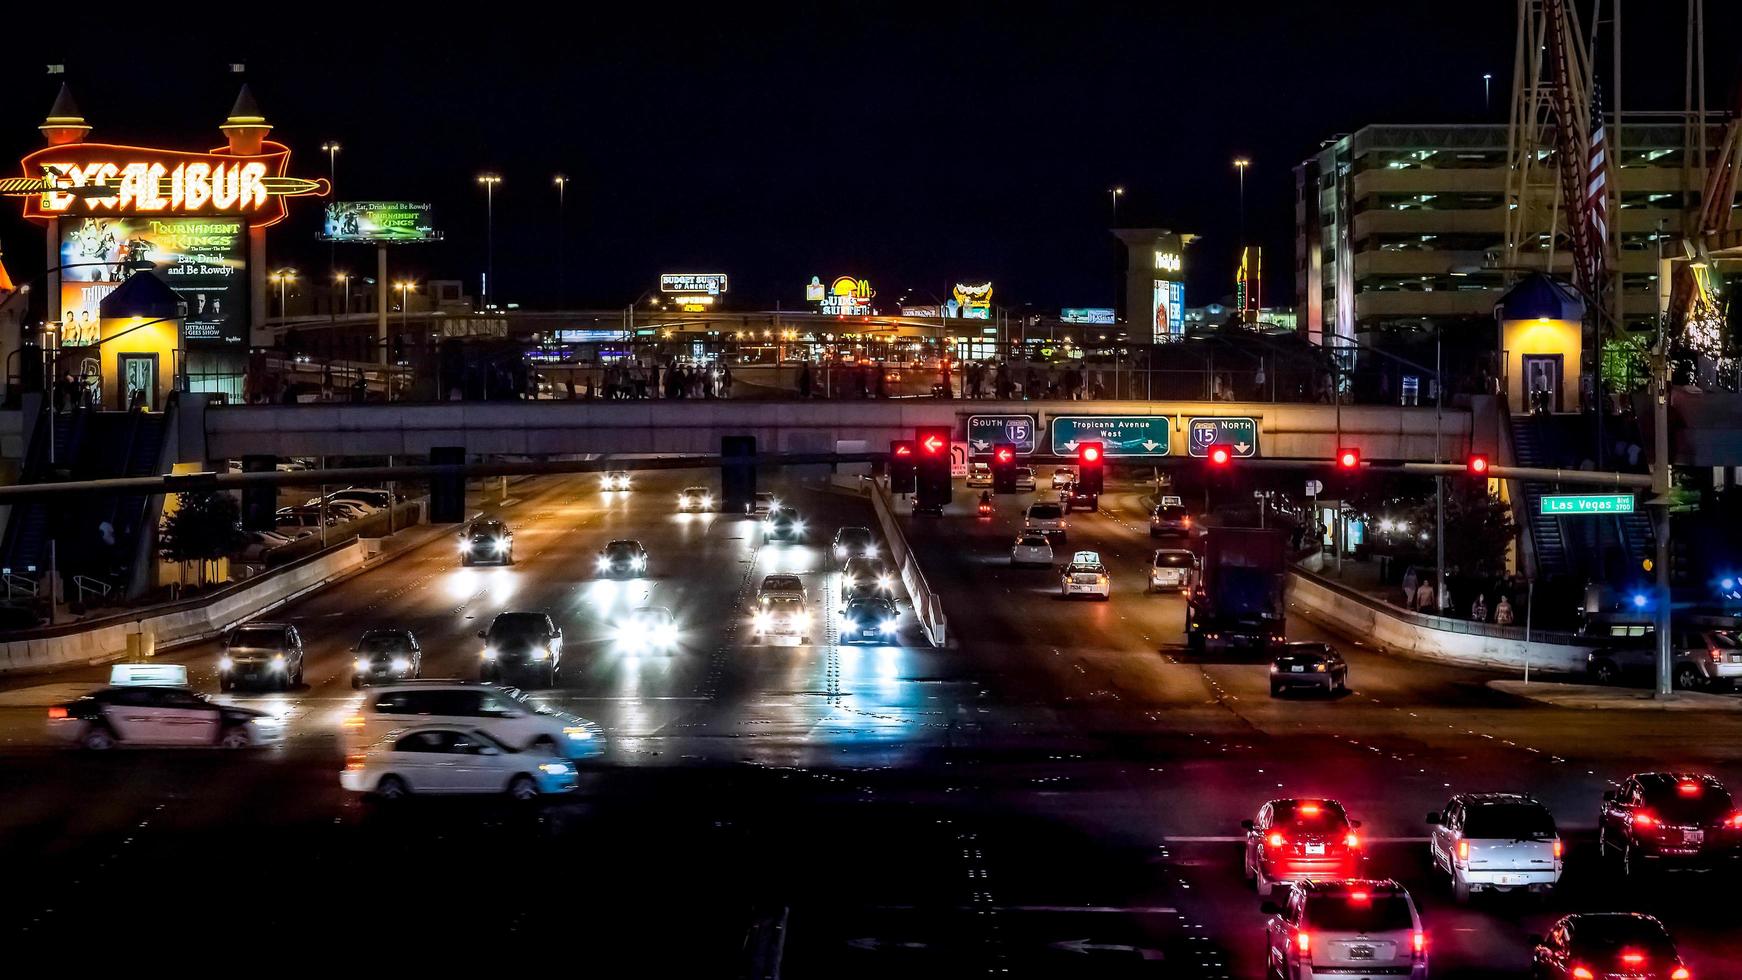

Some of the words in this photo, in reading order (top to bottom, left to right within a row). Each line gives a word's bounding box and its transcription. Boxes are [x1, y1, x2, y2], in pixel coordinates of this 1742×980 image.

[40, 162, 267, 211] EXCALIBUR
[356, 203, 368, 211] Eat,
[409, 203, 431, 211] Rowdy!
[367, 211, 420, 220] TOURNAMENT
[150, 221, 240, 235] TOURNAMENT
[171, 234, 233, 249] KINGS
[178, 254, 195, 265] Eat,
[197, 253, 225, 264] Drink
[167, 265, 184, 275] and
[186, 265, 198, 275] Be
[200, 265, 234, 277] Rowdy!
[684, 281, 710, 290] AMERIC
[973, 419, 1003, 427] SOUTH
[1072, 421, 1115, 429] Tropicana
[1221, 421, 1251, 429] NORTH
[1009, 426, 1026, 439] 15
[1198, 429, 1214, 442] 15
[1551, 500, 1574, 510] Las
[1578, 500, 1612, 512] Vegas
